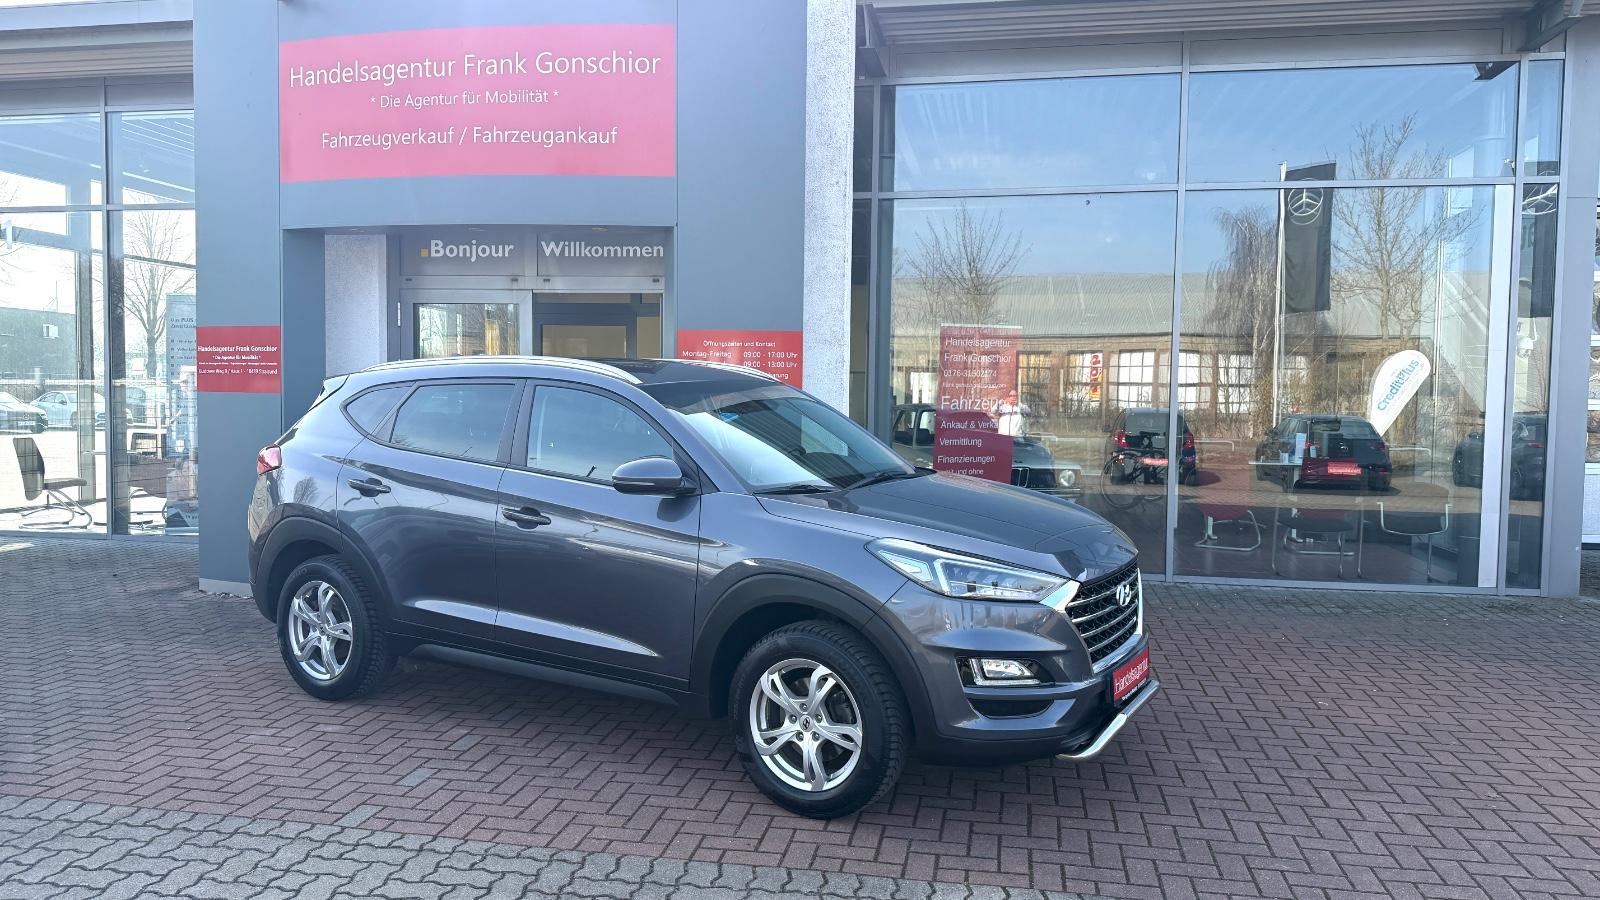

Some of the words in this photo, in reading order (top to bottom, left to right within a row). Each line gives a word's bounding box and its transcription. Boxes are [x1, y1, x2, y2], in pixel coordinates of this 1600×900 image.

[290, 58, 457, 87] Handelsagentur
[464, 51, 528, 76] Frank
[535, 49, 662, 75] Gonschior
[380, 94, 401, 108] Die
[405, 93, 458, 109] Agentur
[462, 90, 481, 105] für
[485, 89, 549, 104] Mobilität
[322, 126, 454, 150] Fahrzeugverkauf
[459, 127, 467, 145] /
[473, 126, 618, 148] Fahrzeugankauf
[540, 240, 664, 257] Willkommen
[703, 340, 743, 348] Öffnungszeiten
[945, 337, 1011, 348] Handelsagentur
[197, 345, 235, 353] Handelsagentur
[944, 352, 969, 362] Frank
[971, 353, 1011, 362] Gonschior
[940, 420, 968, 429] Ankauf
[969, 420, 976, 429] &
[939, 437, 982, 447] Vermittlung
[937, 454, 996, 464] Finanzierungen
